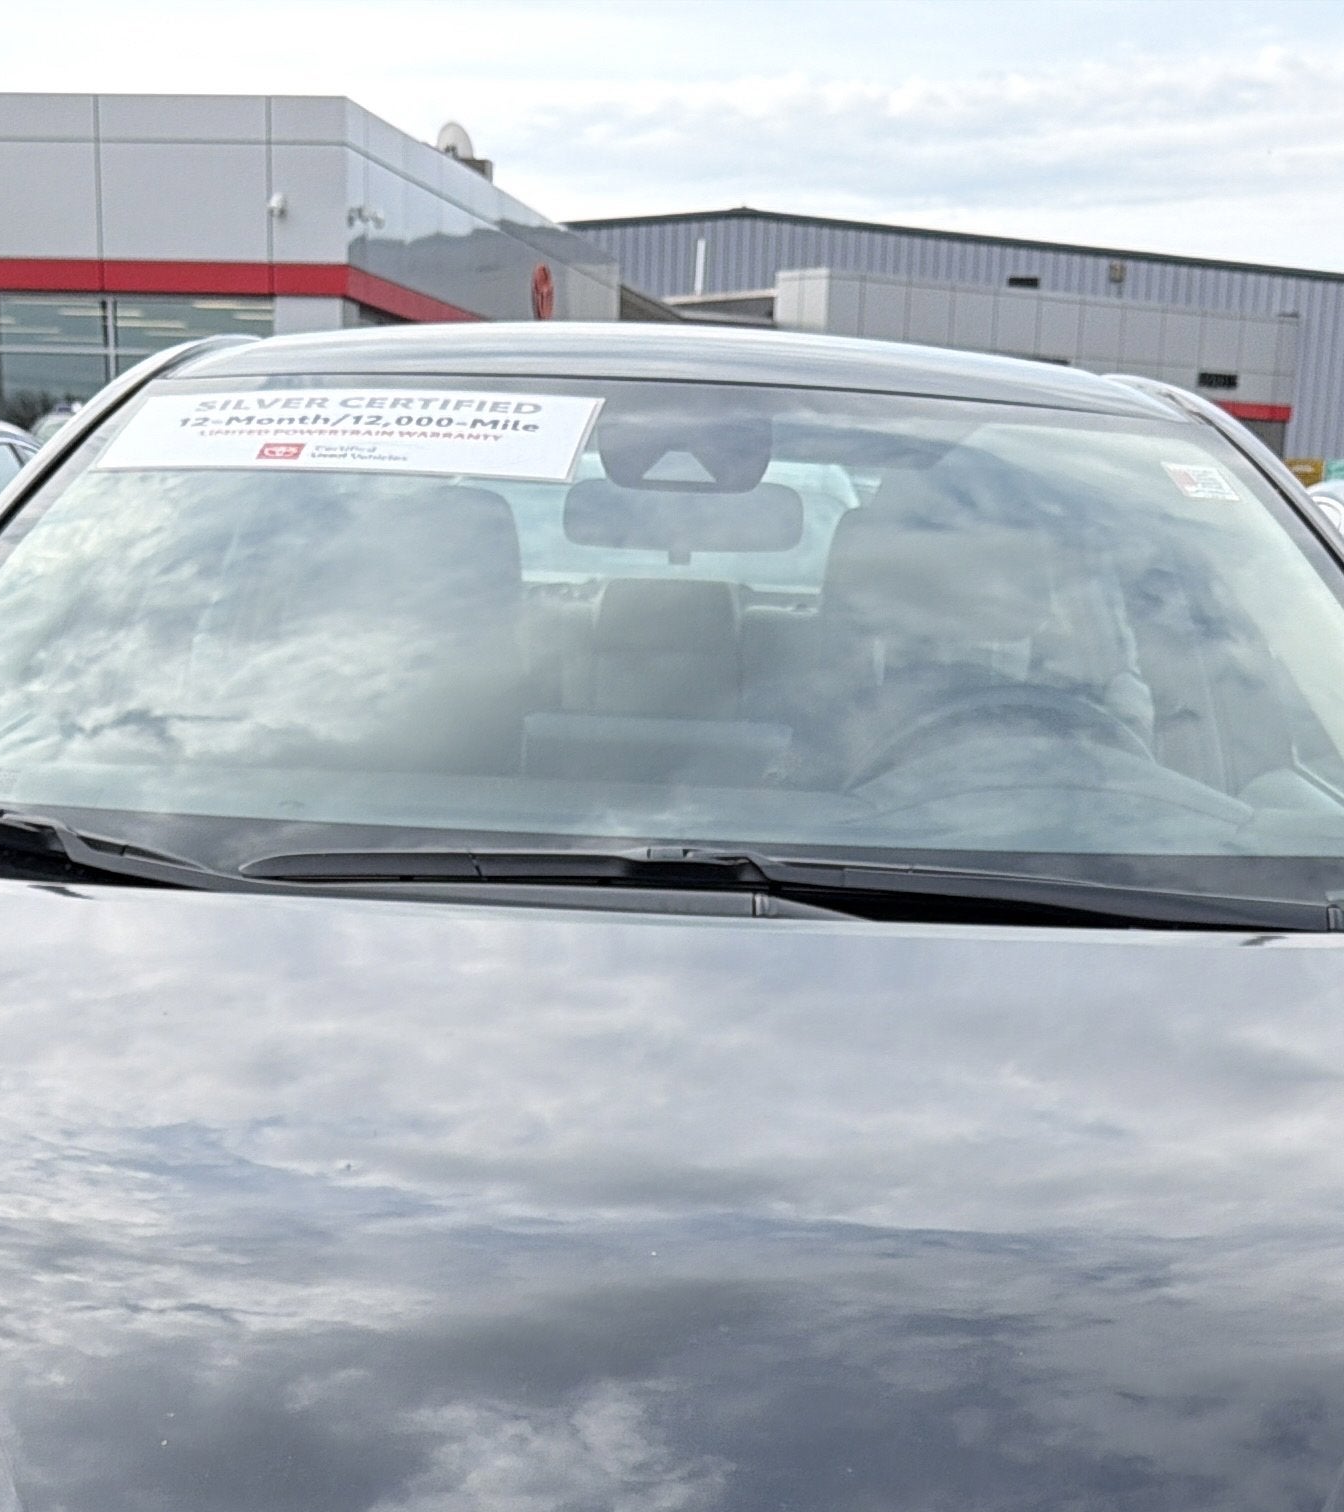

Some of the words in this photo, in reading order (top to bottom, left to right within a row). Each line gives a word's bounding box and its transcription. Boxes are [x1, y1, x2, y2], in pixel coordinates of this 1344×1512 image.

[195, 397, 330, 412] SILVER
[339, 396, 542, 415] CERTIFIED
[180, 413, 540, 433] 12-Month/12,000-Mile
[199, 428, 270, 437] LIMITED
[273, 428, 395, 438] POWERTRAIN
[398, 430, 503, 442] WARRANTY
